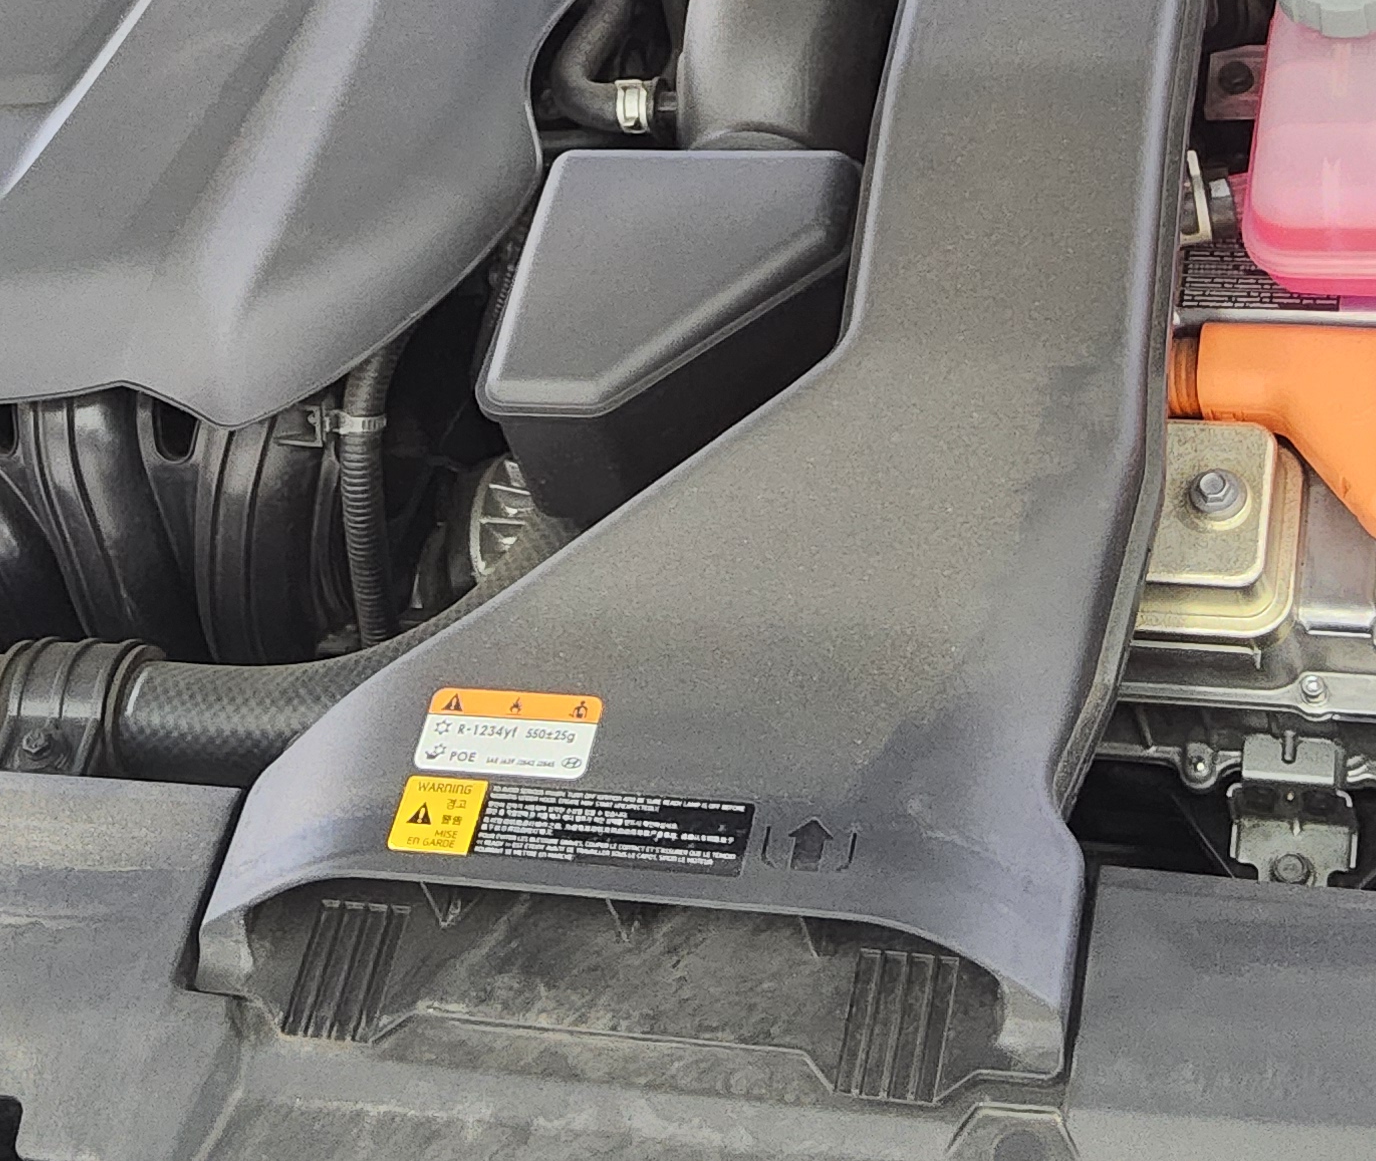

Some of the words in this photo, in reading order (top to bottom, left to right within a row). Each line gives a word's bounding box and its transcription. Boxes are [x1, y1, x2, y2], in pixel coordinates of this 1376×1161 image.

[457, 723, 518, 739] R-1234yf
[525, 728, 576, 743] 550±25g
[449, 751, 477, 762] POE
[418, 782, 473, 795] WARNING
[447, 799, 467, 810] 경고
[434, 830, 458, 839] MISE
[407, 836, 420, 845] EN
[422, 838, 455, 849] GARDE
